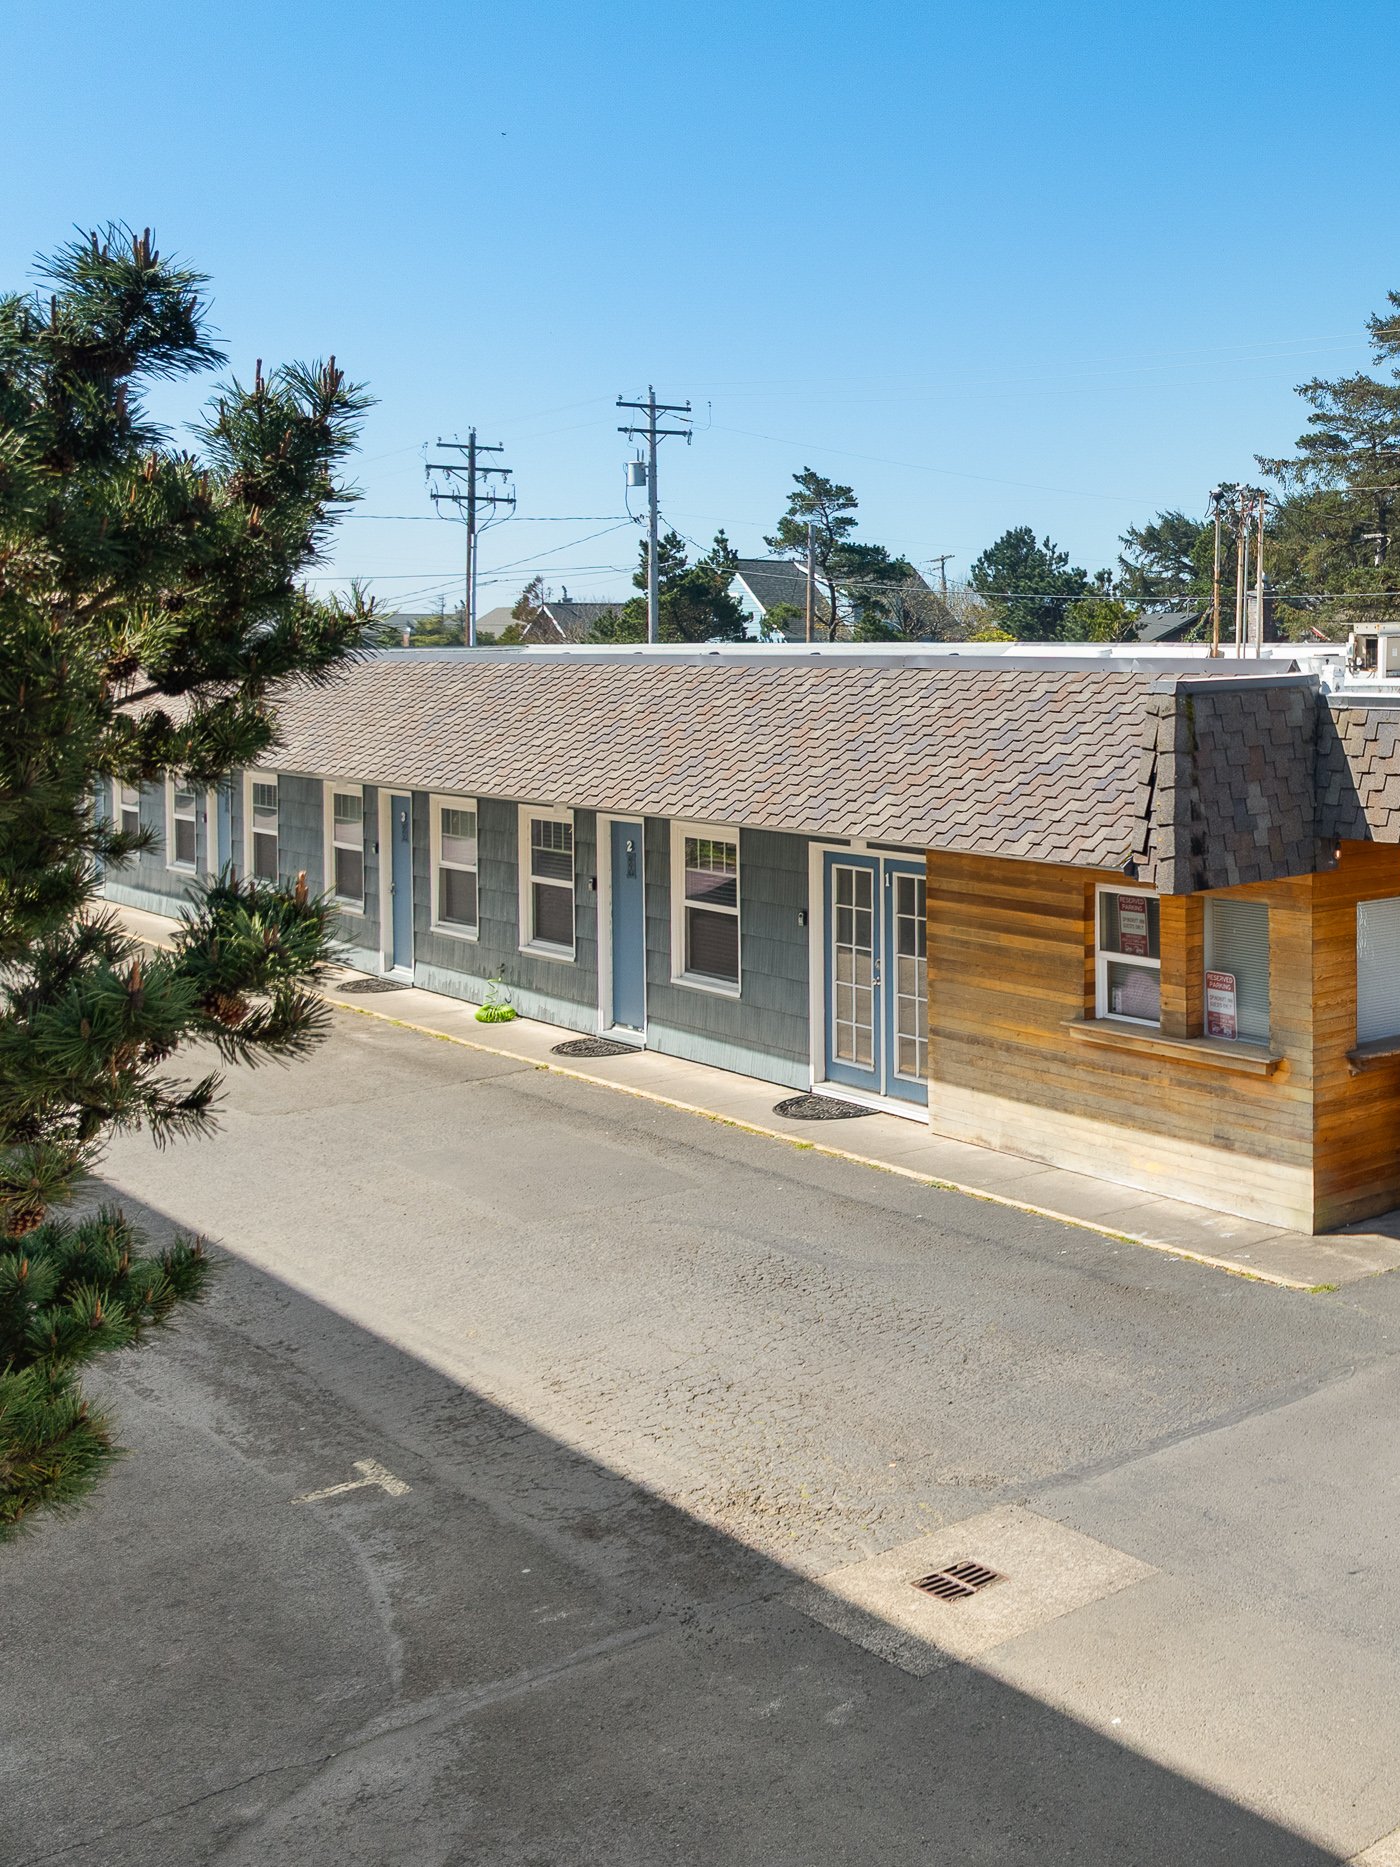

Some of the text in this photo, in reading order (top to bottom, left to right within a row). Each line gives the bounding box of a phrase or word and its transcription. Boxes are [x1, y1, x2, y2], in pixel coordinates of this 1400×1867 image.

[626, 840, 633, 852] 2
[885, 872, 890, 887] 1
[1119, 896, 1144, 905] RESERVED
[1121, 904, 1143, 912] PARKING
[1207, 973, 1233, 984] RESERVED
[1209, 981, 1231, 991] PARKING
